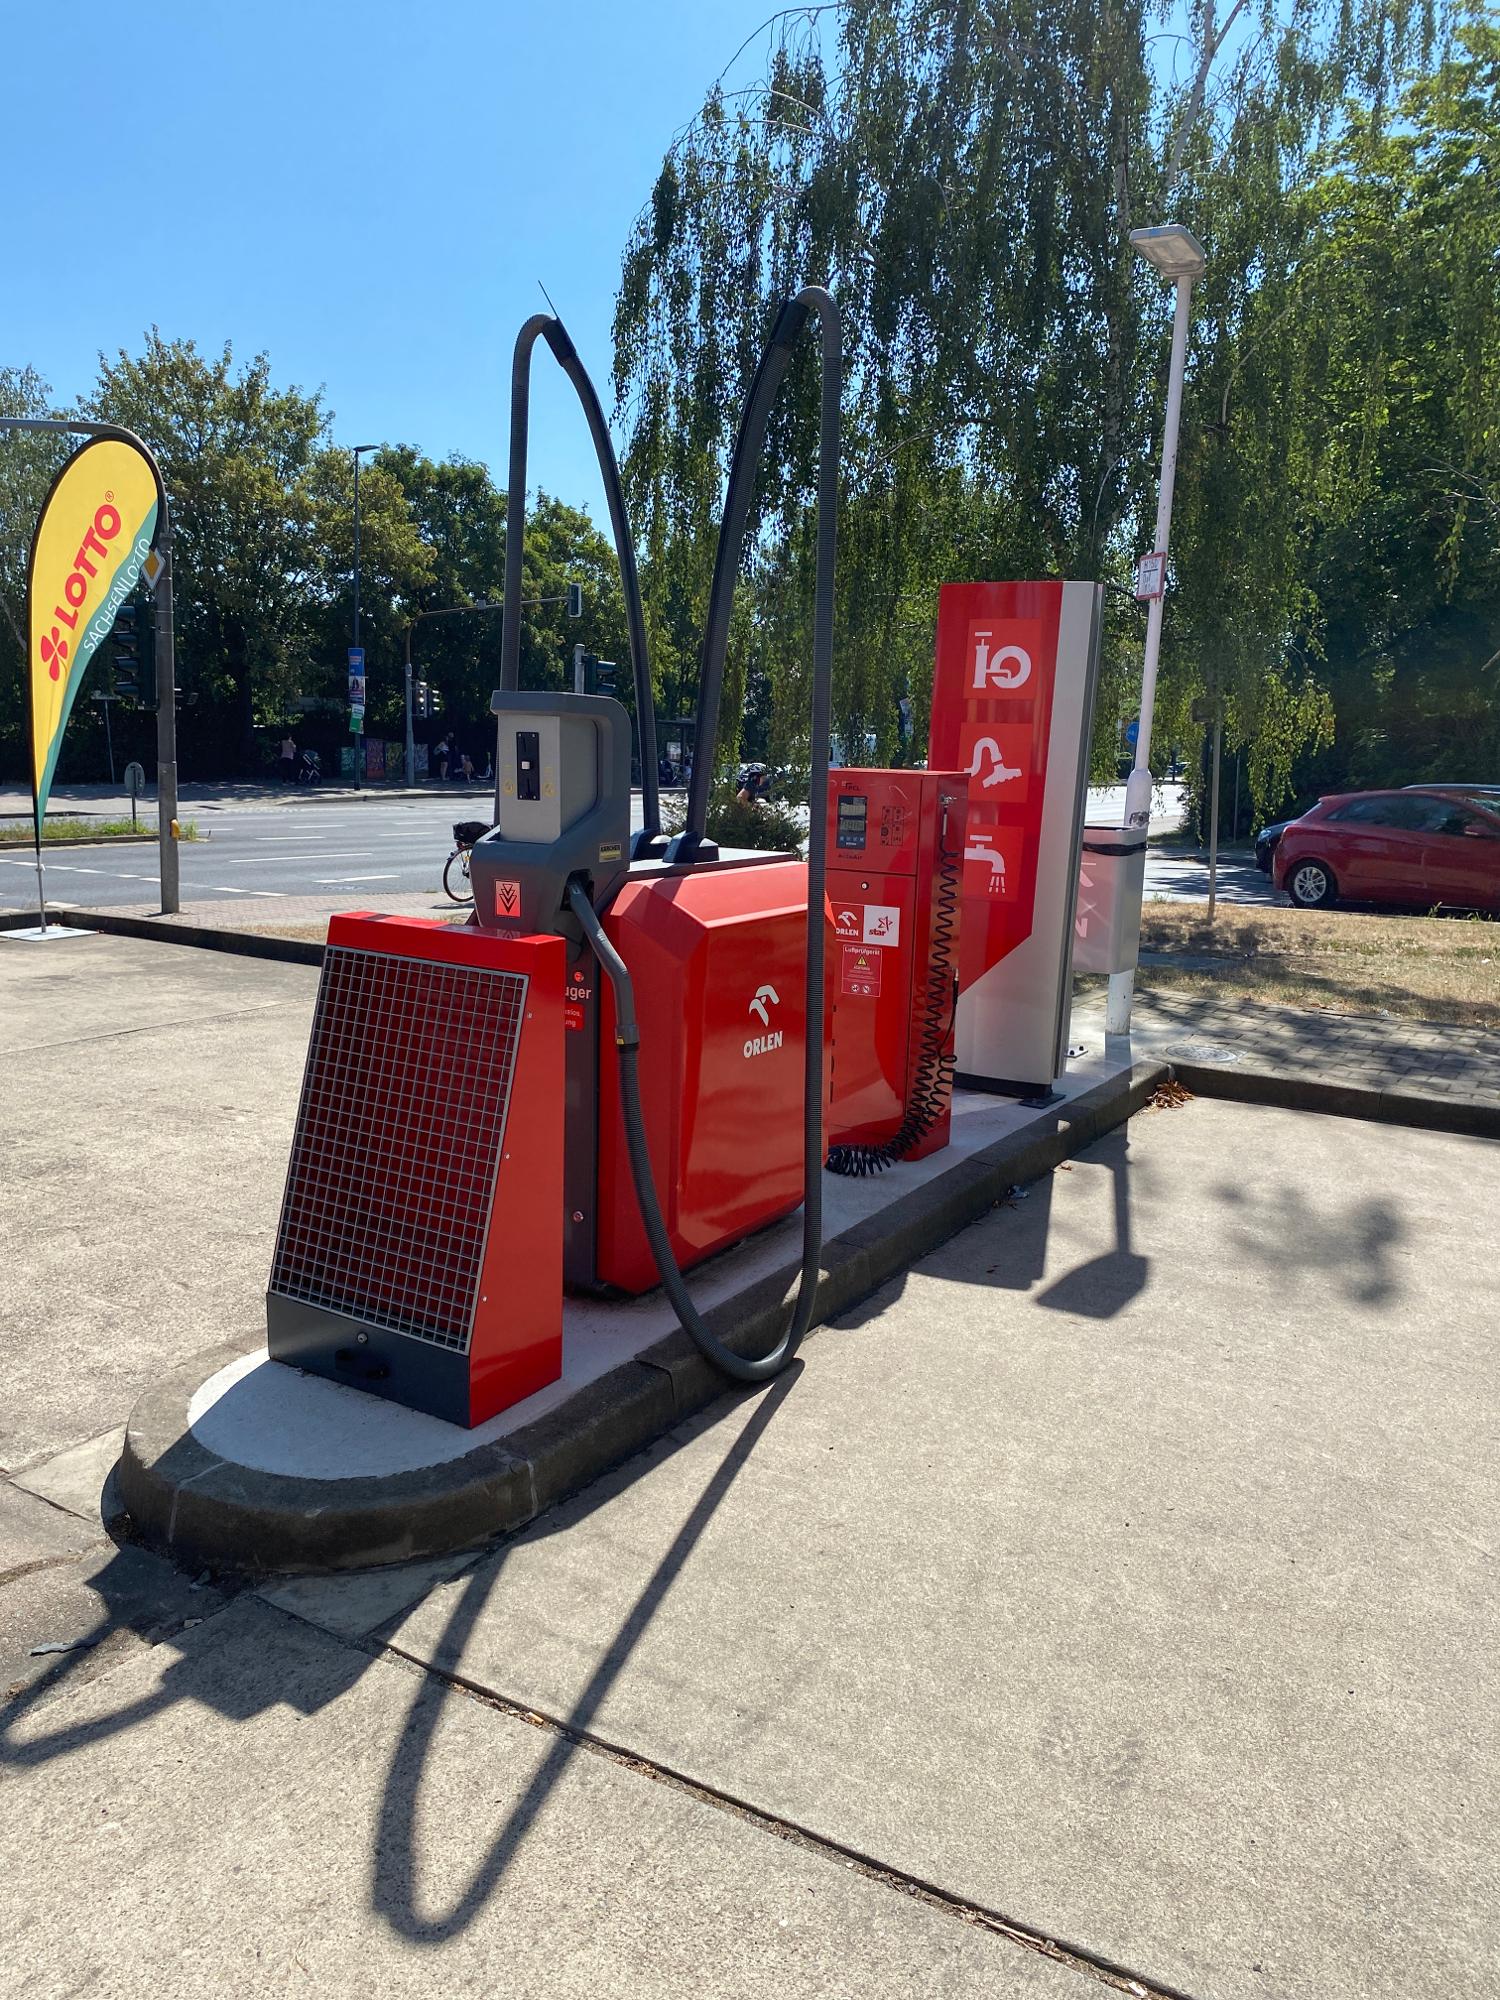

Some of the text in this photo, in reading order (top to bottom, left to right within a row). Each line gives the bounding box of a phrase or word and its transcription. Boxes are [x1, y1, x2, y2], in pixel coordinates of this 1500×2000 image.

[54, 504, 121, 630] LOTTO
[83, 538, 151, 654] SACHSENLOTTO
[836, 928, 859, 936] ORLEN
[869, 928, 886, 937] star
[743, 1030, 783, 1058] ORLEN
